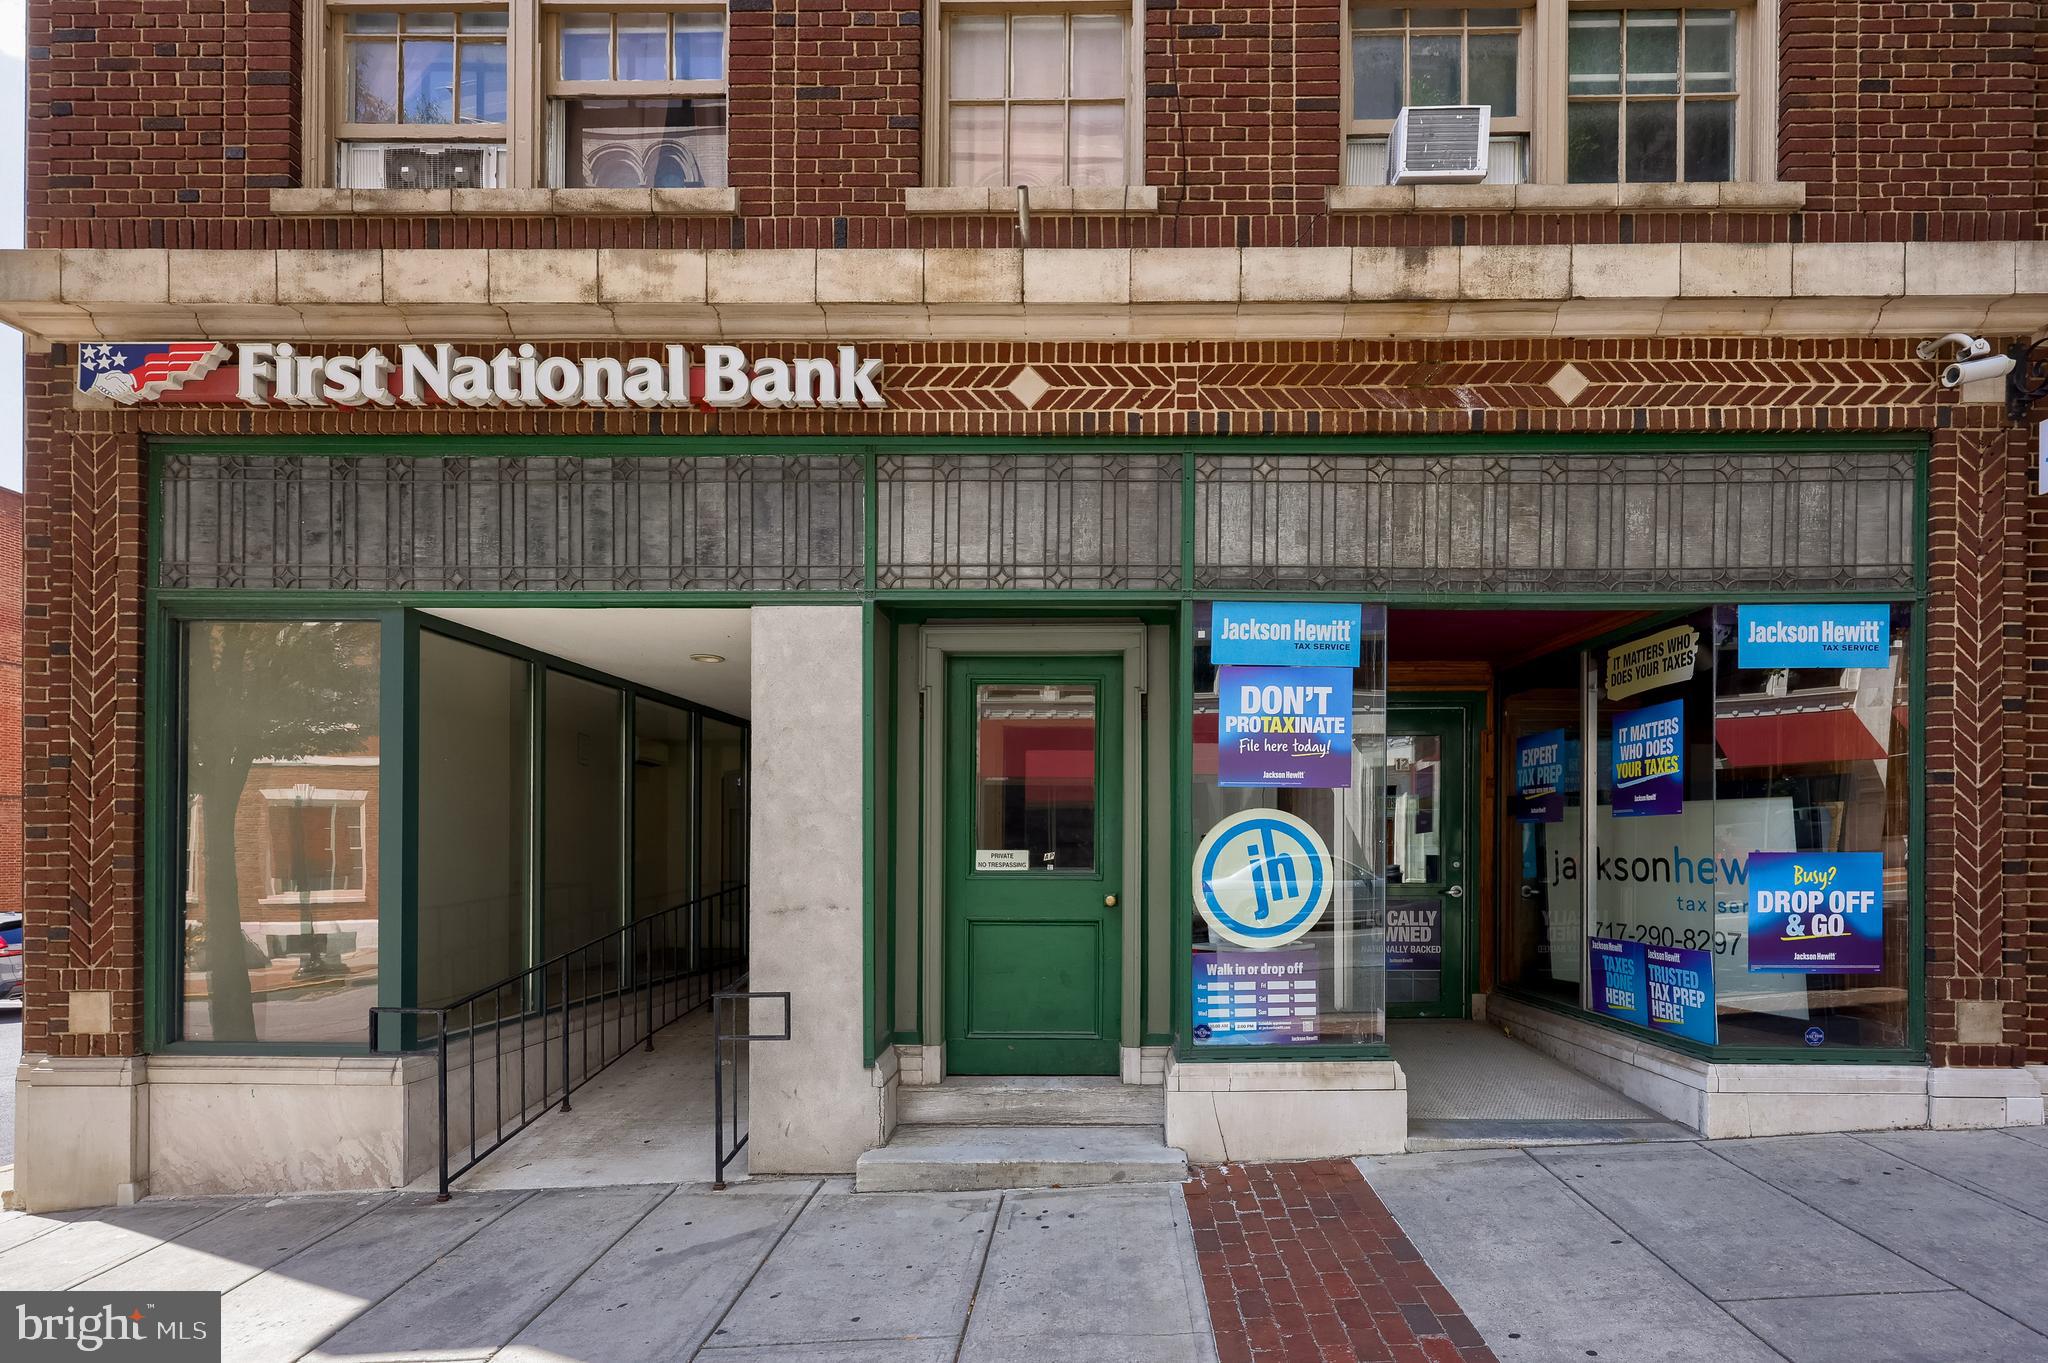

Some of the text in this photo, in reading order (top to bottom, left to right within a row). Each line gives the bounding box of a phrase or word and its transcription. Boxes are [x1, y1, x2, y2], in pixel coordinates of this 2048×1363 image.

[236, 342, 887, 408] First National Bank
[1221, 617, 1351, 641] Jackson Hewitt
[1748, 620, 1880, 643] Jackson Hewitt
[1294, 642, 1351, 651] TAX SERVICE
[1613, 633, 1691, 671] IT MATTERS WHO
[1611, 650, 1694, 687] DOES YOUR TAXES
[1240, 685, 1333, 715] DON'T
[1225, 716, 1345, 734] PROTAXINATE
[1619, 717, 1679, 744] IT MATTERS
[1239, 737, 1331, 758] File here today!
[1522, 744, 1558, 767] EXPERT
[1620, 737, 1674, 761] WHO DOES
[1263, 771, 1304, 779] Jackson Hewitt
[1517, 767, 1535, 787] TAX
[1537, 764, 1562, 785] PREP
[1616, 755, 1679, 779] YOUR TAXES
[1793, 865, 1837, 890] Busy?
[1676, 896, 1749, 914] tax ser
[1757, 890, 1875, 914] DROP OFF
[1785, 914, 1845, 936] & GO
[1410, 945, 1441, 953] BACKED
[1592, 940, 1608, 950] Jackson
[1596, 921, 1742, 956] 717-290-8297
[1602, 955, 1634, 976] TAXES
[1648, 949, 1680, 963] Jackson Hewitt
[1794, 952, 1836, 960] Jackson Hewitt
[1206, 962, 1304, 976] Walk in or drop off
[1648, 964, 1699, 989] TRUSTED
[1606, 971, 1633, 991] DONE
[1606, 987, 1635, 1009] HERE!
[1649, 981, 1705, 1009] TAX PREP
[1652, 999, 1684, 1023] HERE!
